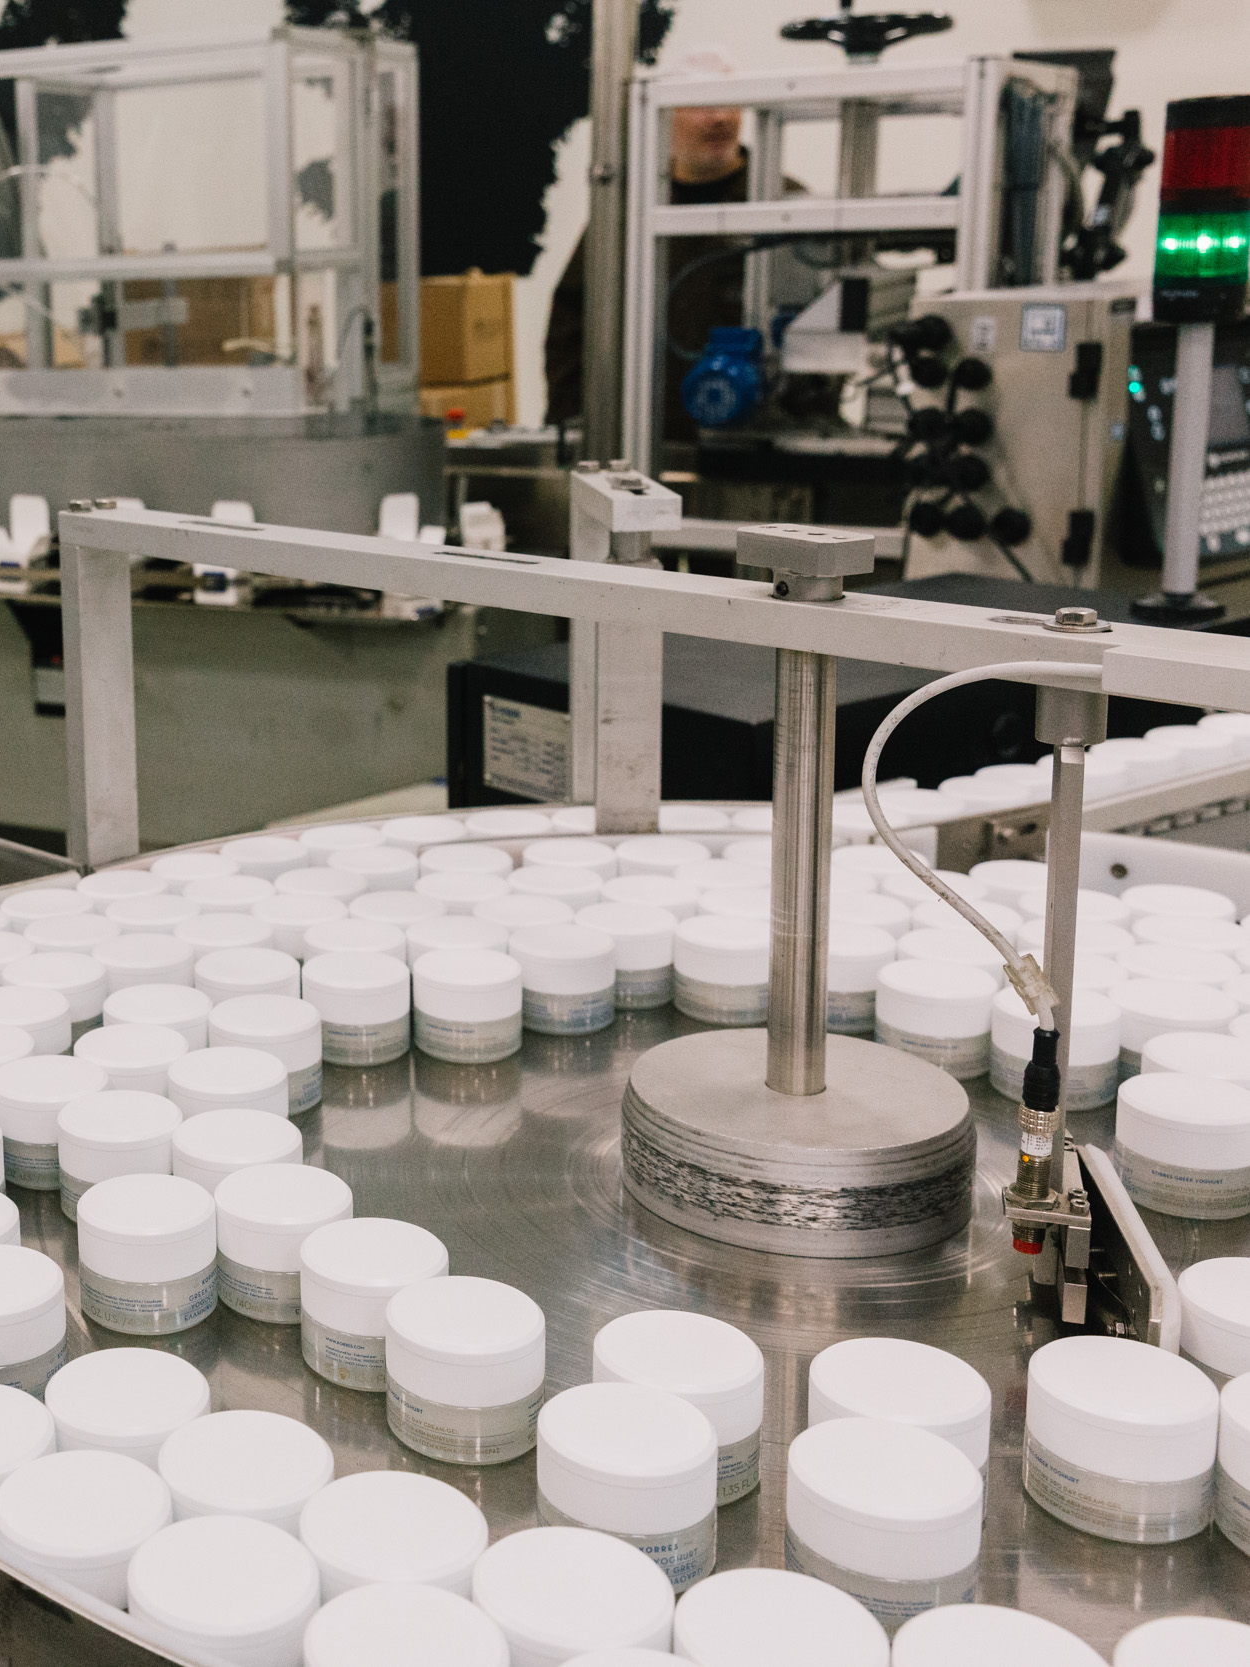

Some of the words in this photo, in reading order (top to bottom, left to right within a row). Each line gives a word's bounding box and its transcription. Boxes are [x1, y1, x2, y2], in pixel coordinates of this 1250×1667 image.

[1050, 1465, 1080, 1484] YOGHURT
[722, 1483, 740, 1498] 1.35
[741, 1479, 750, 1490] FL
[638, 1543, 679, 1554] KORRES
[653, 1548, 699, 1565] YOGHURT
[673, 1560, 697, 1574] GREC
